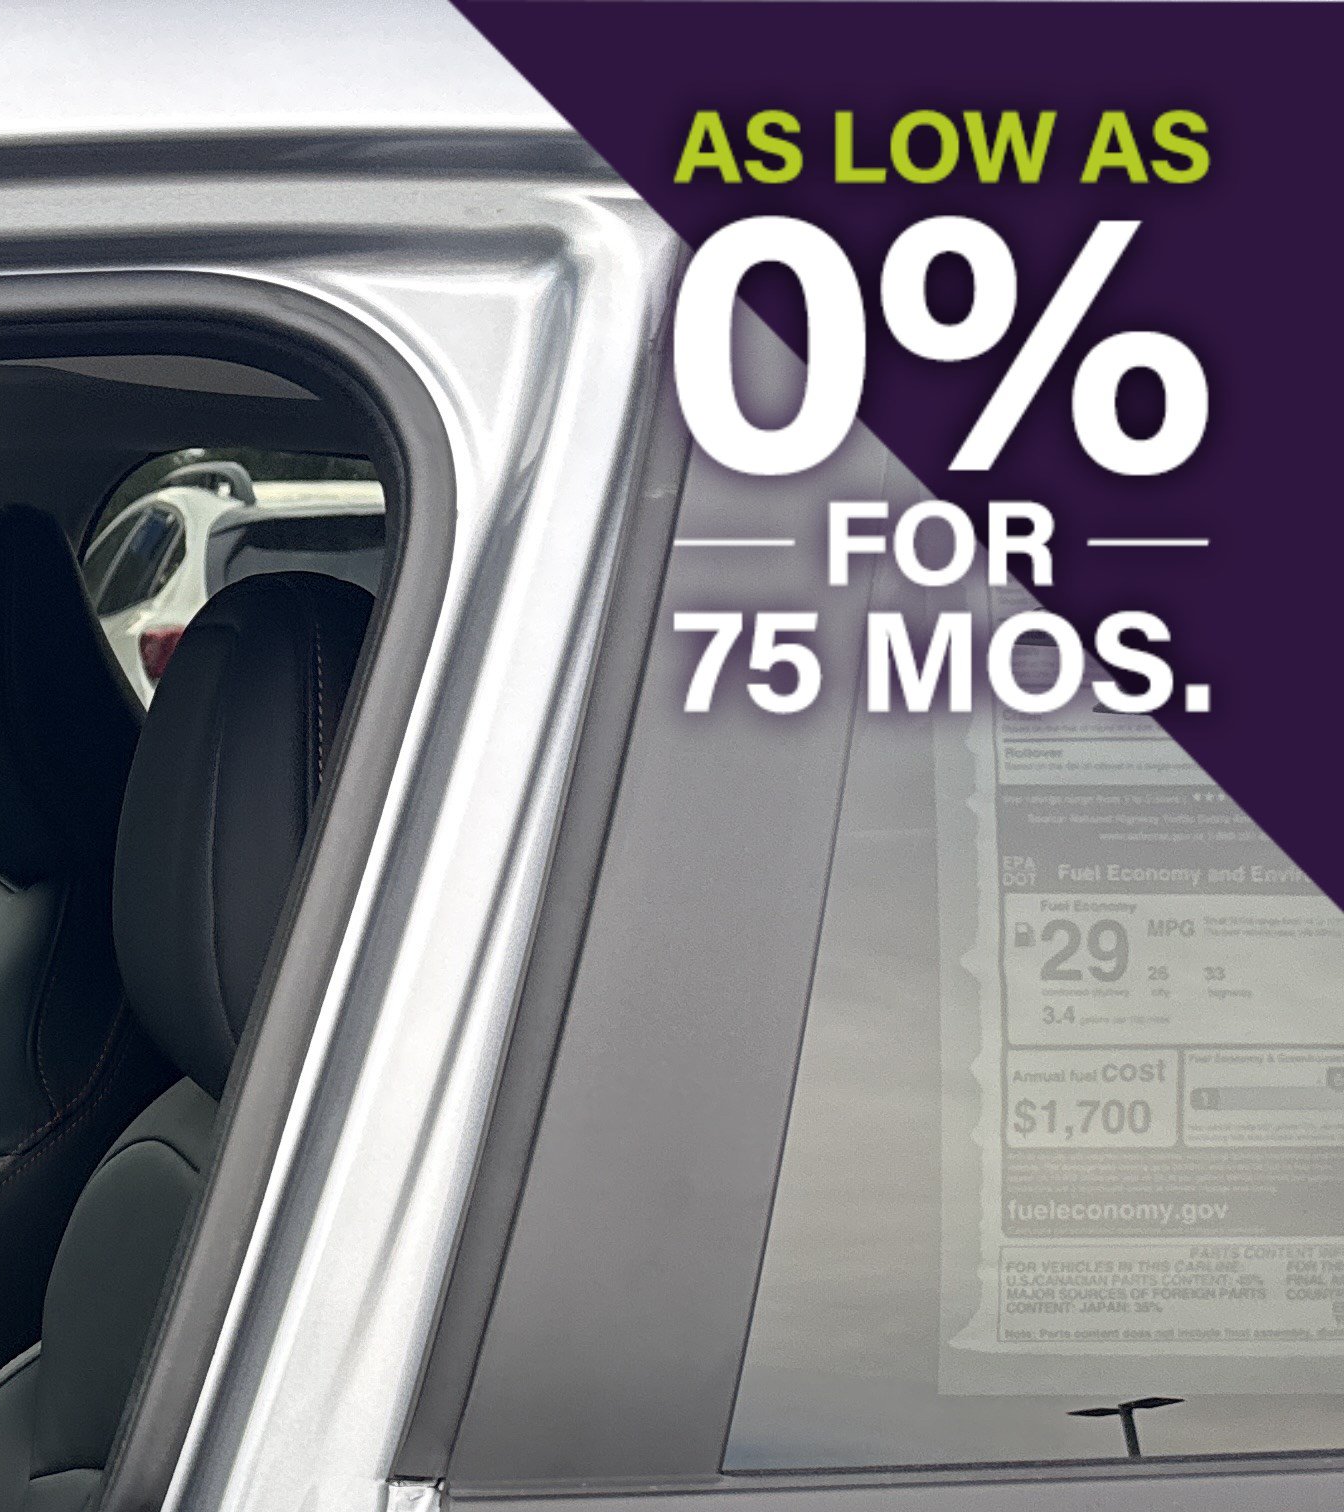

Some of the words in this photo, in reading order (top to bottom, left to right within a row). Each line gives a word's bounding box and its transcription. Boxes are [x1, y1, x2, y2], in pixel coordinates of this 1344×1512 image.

[1057, 864, 1101, 882] Fuel
[1106, 864, 1201, 886] Economy
[1208, 865, 1246, 882] and
[1040, 900, 1069, 912] Fuel
[1073, 900, 1137, 914] Economy
[1146, 918, 1196, 938] MPG
[1040, 917, 1130, 982] 29
[1041, 1005, 1076, 1025] 3.4
[1013, 1069, 1067, 1083] Annual
[1070, 1069, 1097, 1083] fuel
[1101, 1058, 1167, 1083] cost
[1013, 1097, 1152, 1140] $1,700
[1008, 1199, 1229, 1225] fueleconomy.gov
[1005, 1260, 1036, 1273] FOR
[1041, 1260, 1114, 1273] VEHICLES
[1138, 1260, 1171, 1273] THIS
[1112, 1274, 1159, 1287] PARTS
[1005, 1288, 1056, 1301] MAJOR
[1058, 1288, 1127, 1301] SOURCES
[1218, 1288, 1267, 1301] PARTS
